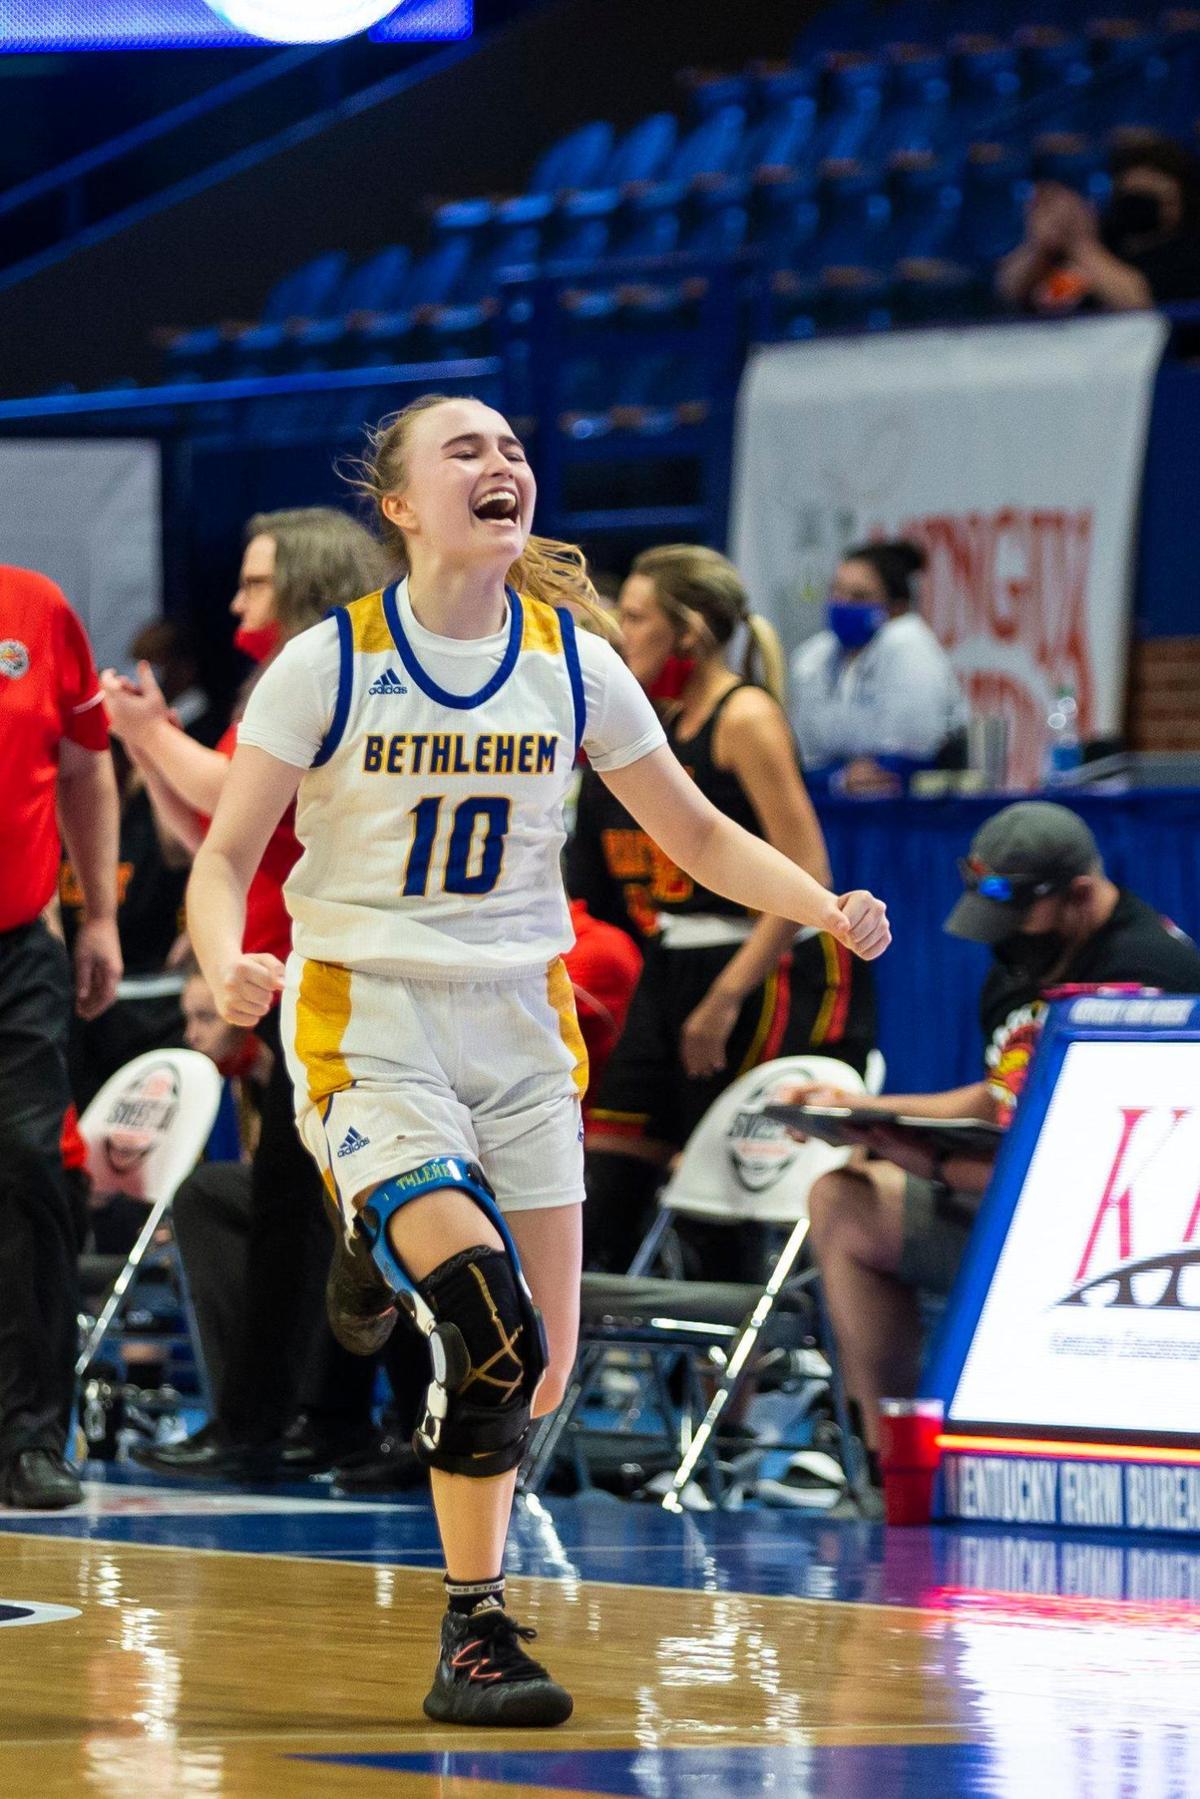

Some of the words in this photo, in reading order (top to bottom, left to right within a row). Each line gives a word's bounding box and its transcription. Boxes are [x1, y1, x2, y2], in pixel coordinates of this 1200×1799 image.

[368, 684, 408, 696] adidas
[363, 733, 559, 775] BETHLEHEM
[401, 794, 512, 897] 10
[337, 1136, 370, 1158] adidas
[1060, 1461, 1123, 1526] FARM
